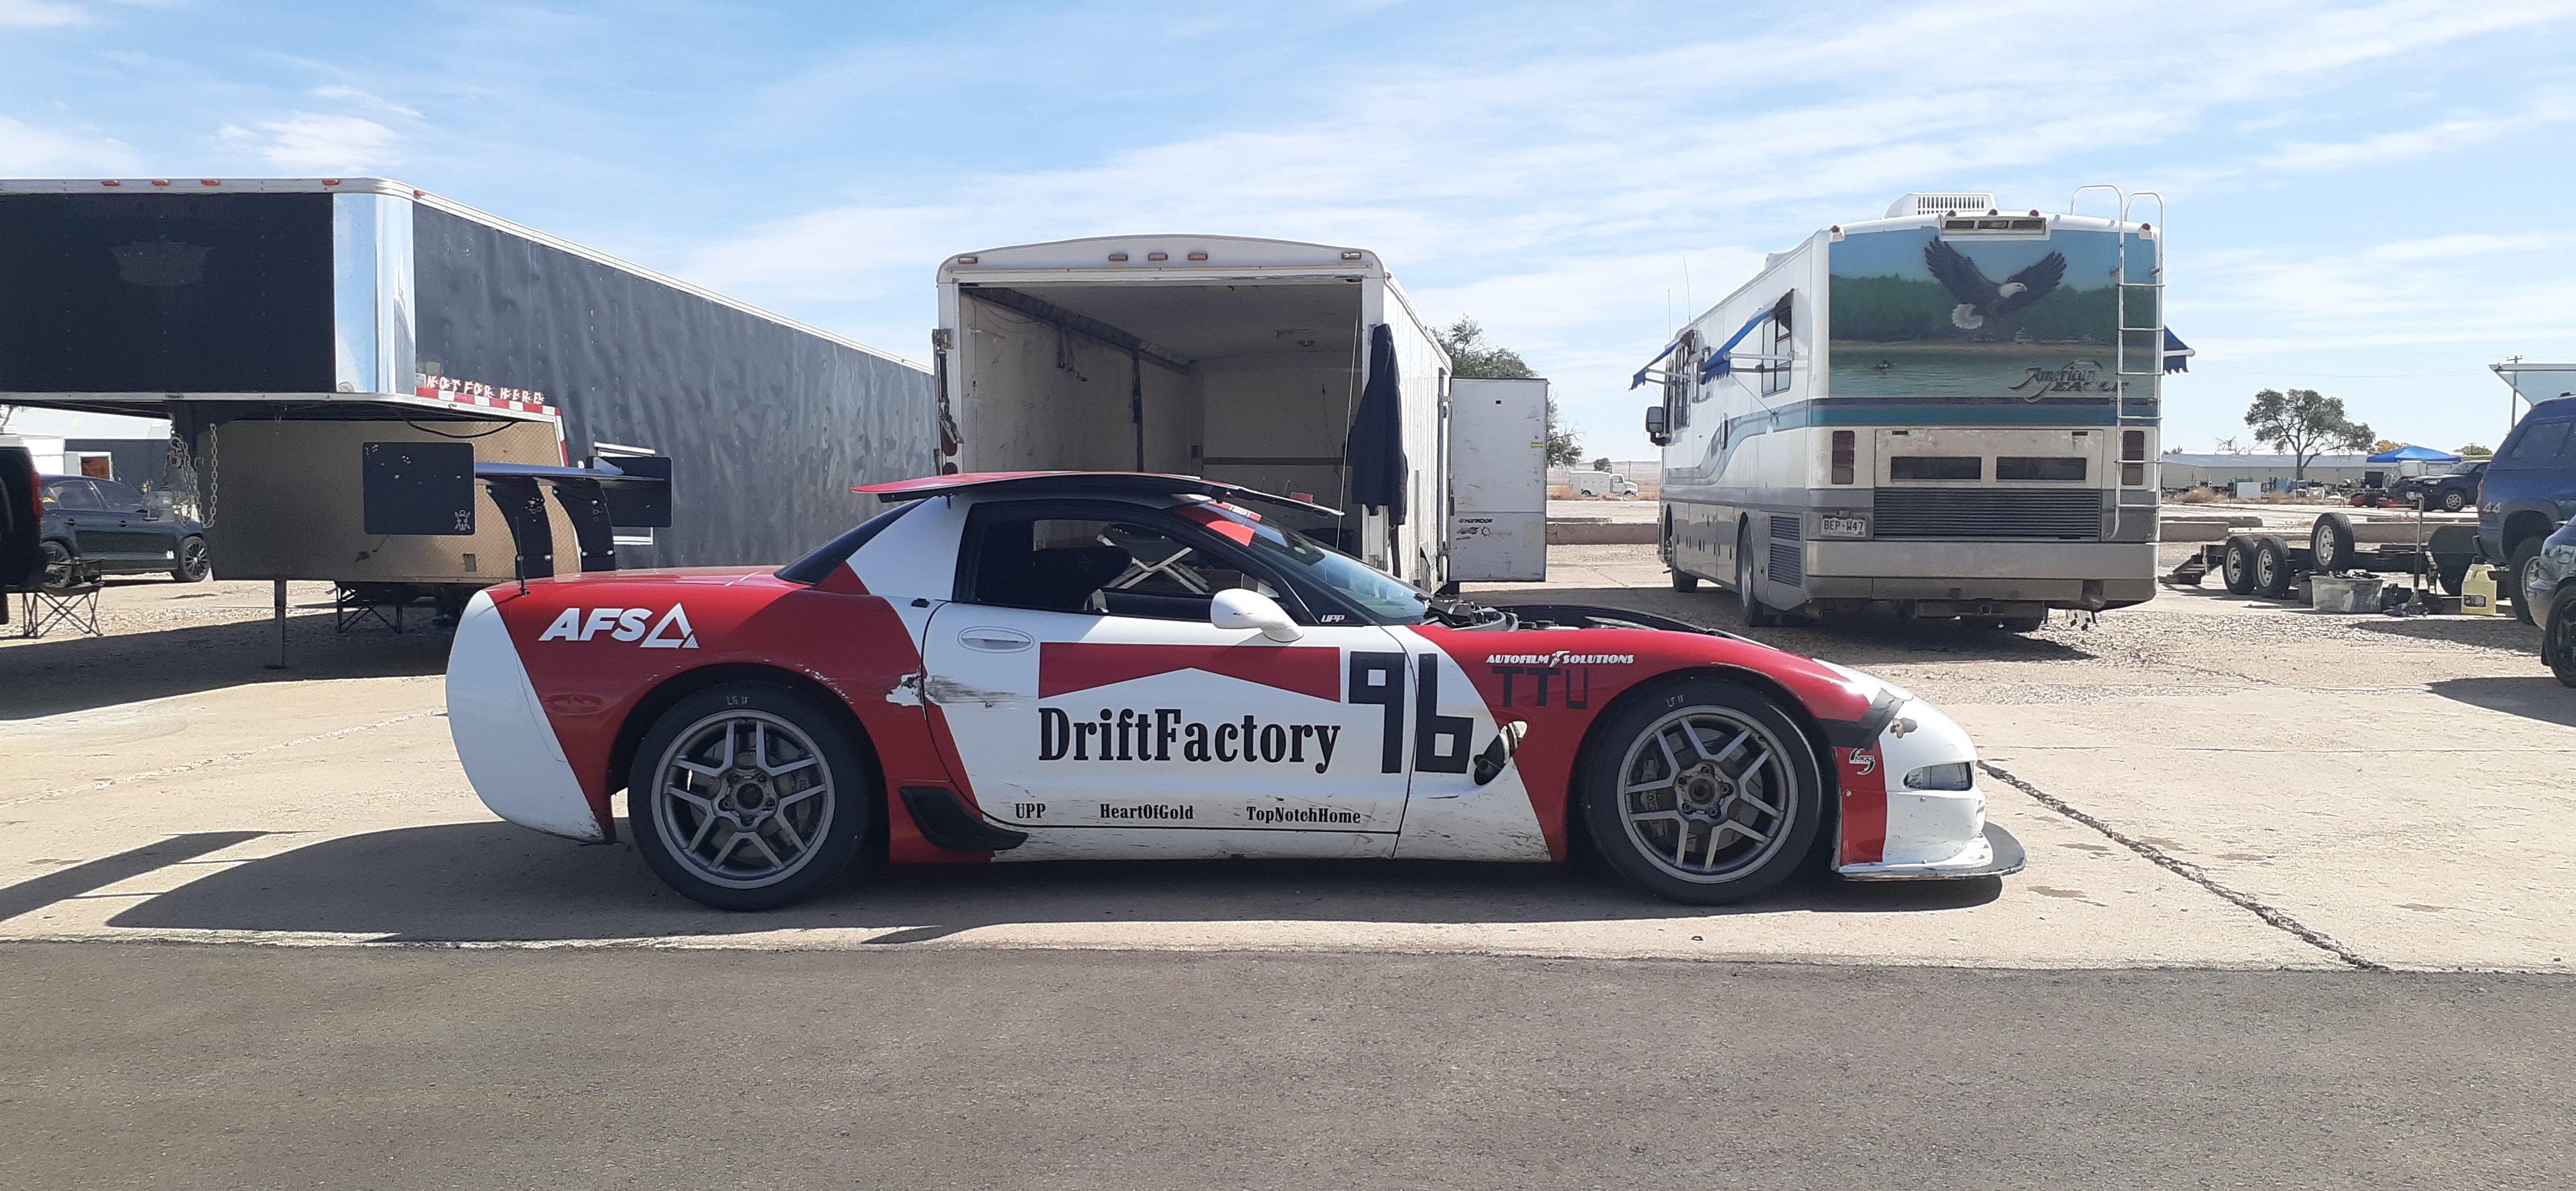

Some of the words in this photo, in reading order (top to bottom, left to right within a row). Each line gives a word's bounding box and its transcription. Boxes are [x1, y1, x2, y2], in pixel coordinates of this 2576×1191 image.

[426, 375, 462, 392] NOT
[464, 380, 496, 398] FOR
[2008, 367, 2097, 403] American
[1320, 614, 1345, 622] UPP
[1485, 654, 1549, 664] AUTOFILM
[1562, 654, 1634, 664] SOLUTIONS
[1492, 665, 1589, 710] TTU
[1348, 650, 1475, 774] 96
[1038, 707, 1341, 774] DriftFactory
[1015, 803, 1046, 819] UPP
[1100, 803, 1194, 820] HeartOfGold
[1246, 806, 1361, 824] TopNotchHome
